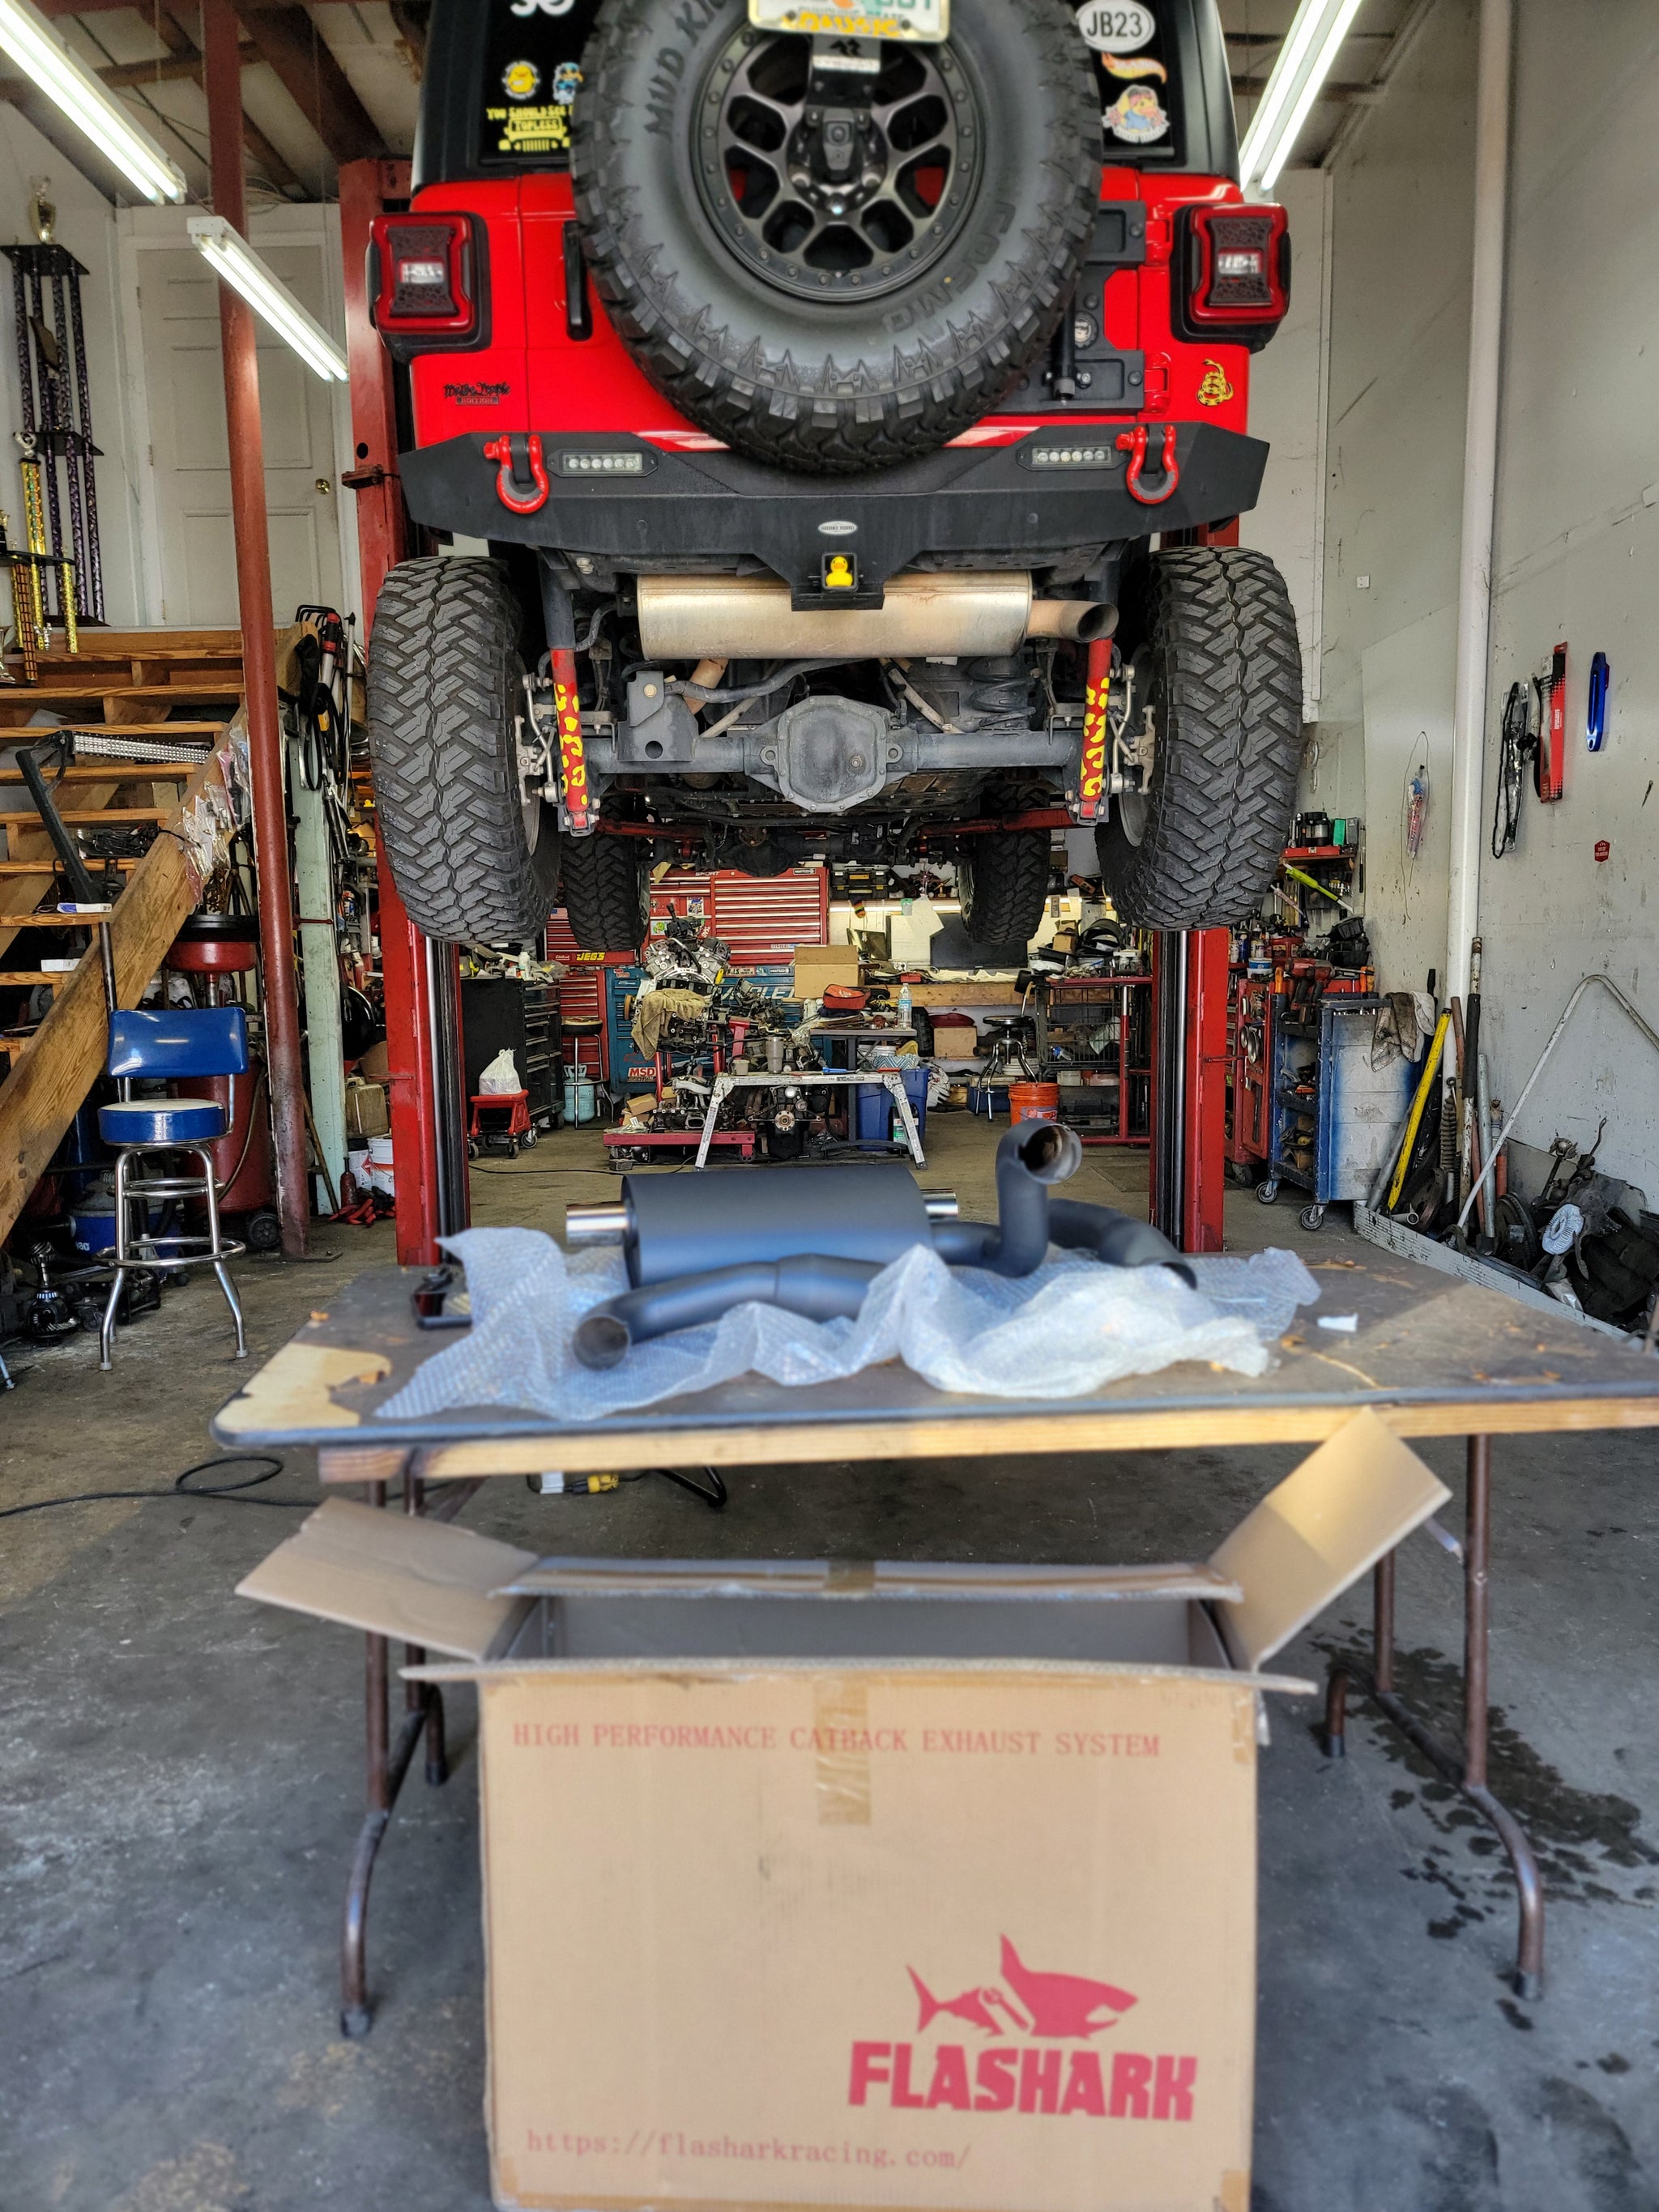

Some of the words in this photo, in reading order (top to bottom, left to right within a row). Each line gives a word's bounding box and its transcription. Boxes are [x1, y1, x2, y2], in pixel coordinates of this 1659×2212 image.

[1087, 11, 1142, 37] JB23
[514, 119, 559, 131] TOPLESS
[629, 1068, 655, 1076] MSD
[513, 1723, 580, 1746] HIGH
[592, 1724, 778, 1750] PERFORMANCE
[789, 1727, 908, 1752] CATBACK
[921, 1729, 1042, 1754] EXHAUST
[1055, 1732, 1161, 1757] SYSTEM
[848, 2040, 1197, 2122] FLASHARK
[527, 2129, 971, 2171] https://flasharkracing.com/
